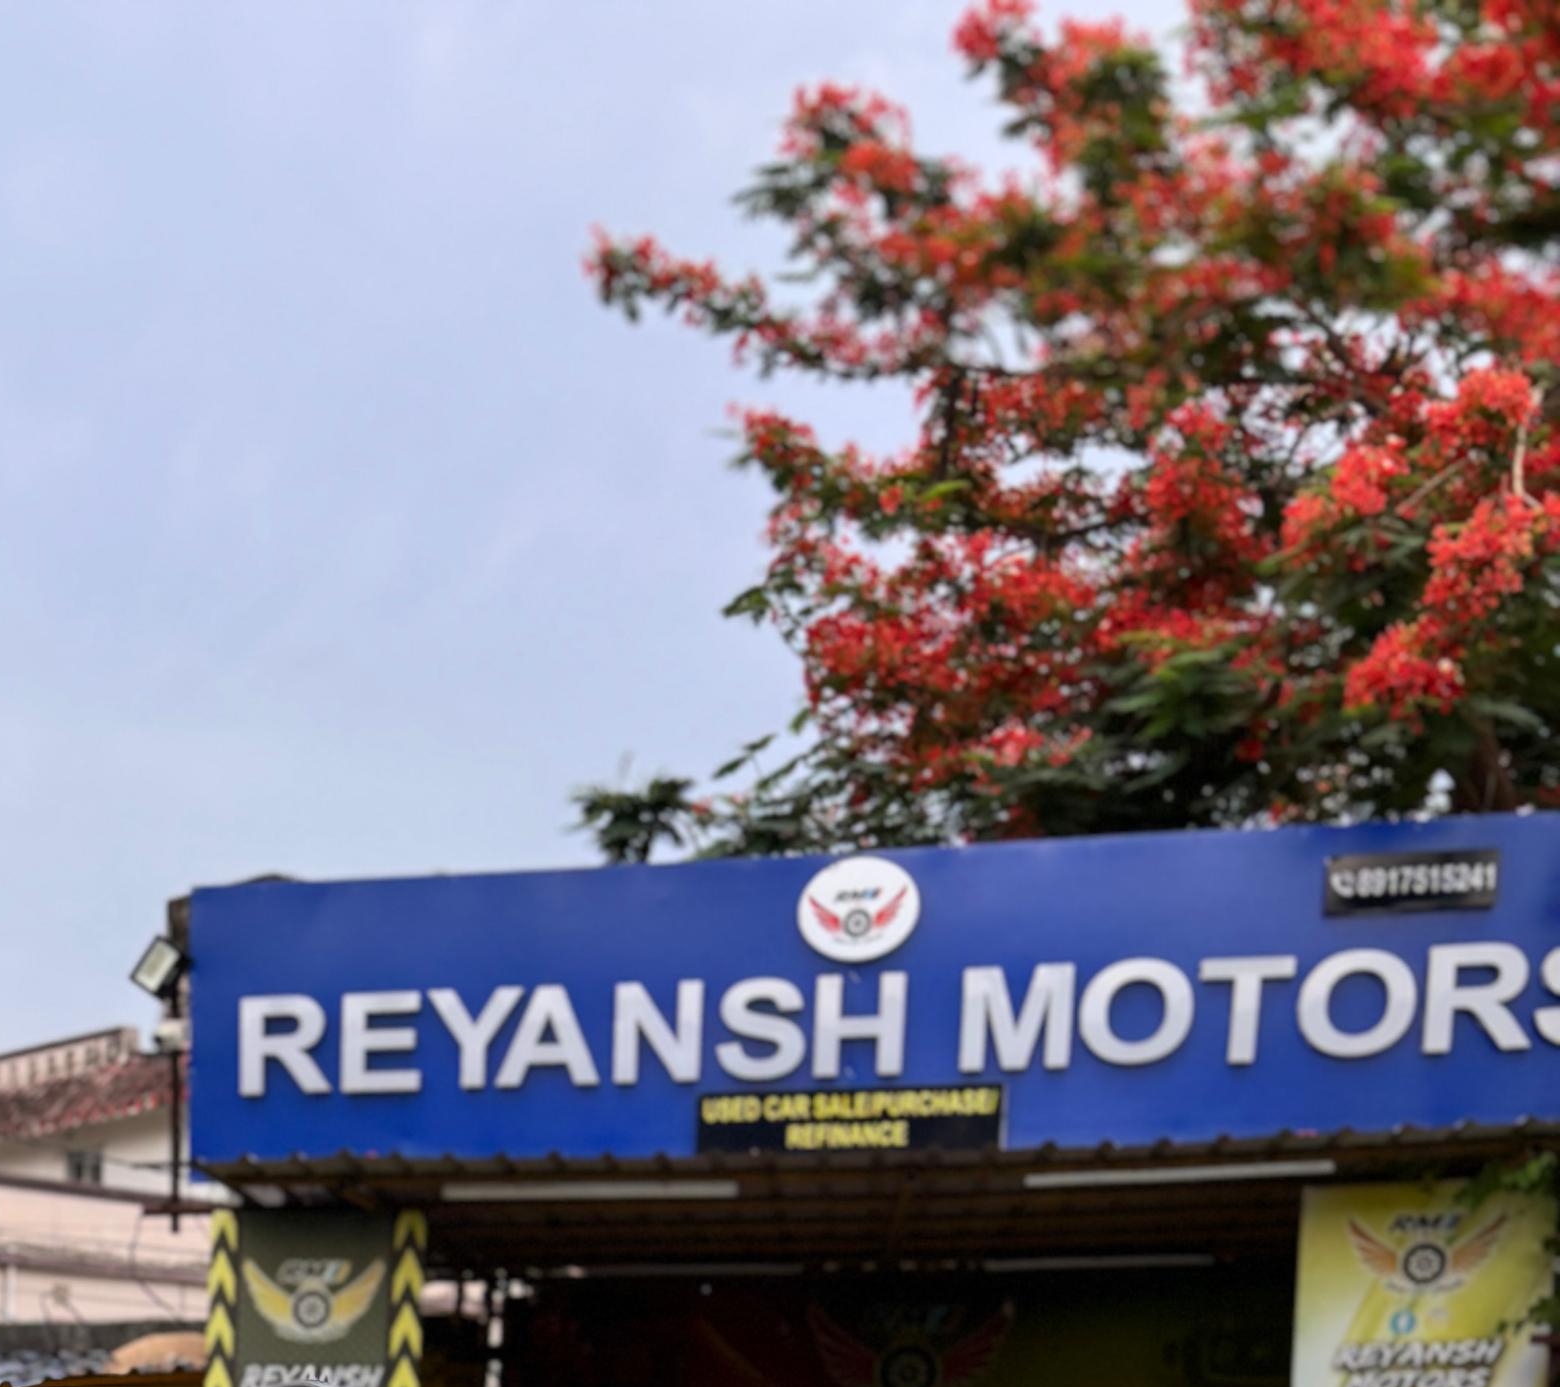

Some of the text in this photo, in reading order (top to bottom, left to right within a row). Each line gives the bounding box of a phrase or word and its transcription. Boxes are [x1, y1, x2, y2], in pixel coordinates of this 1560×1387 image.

[239, 941, 1560, 1097] REYANSH MOTOR
[701, 1096, 762, 1125] USED
[764, 1093, 811, 1121] CAR
[785, 1119, 909, 1149] REFINANCE
[1333, 1336, 1504, 1371] REYANSH
